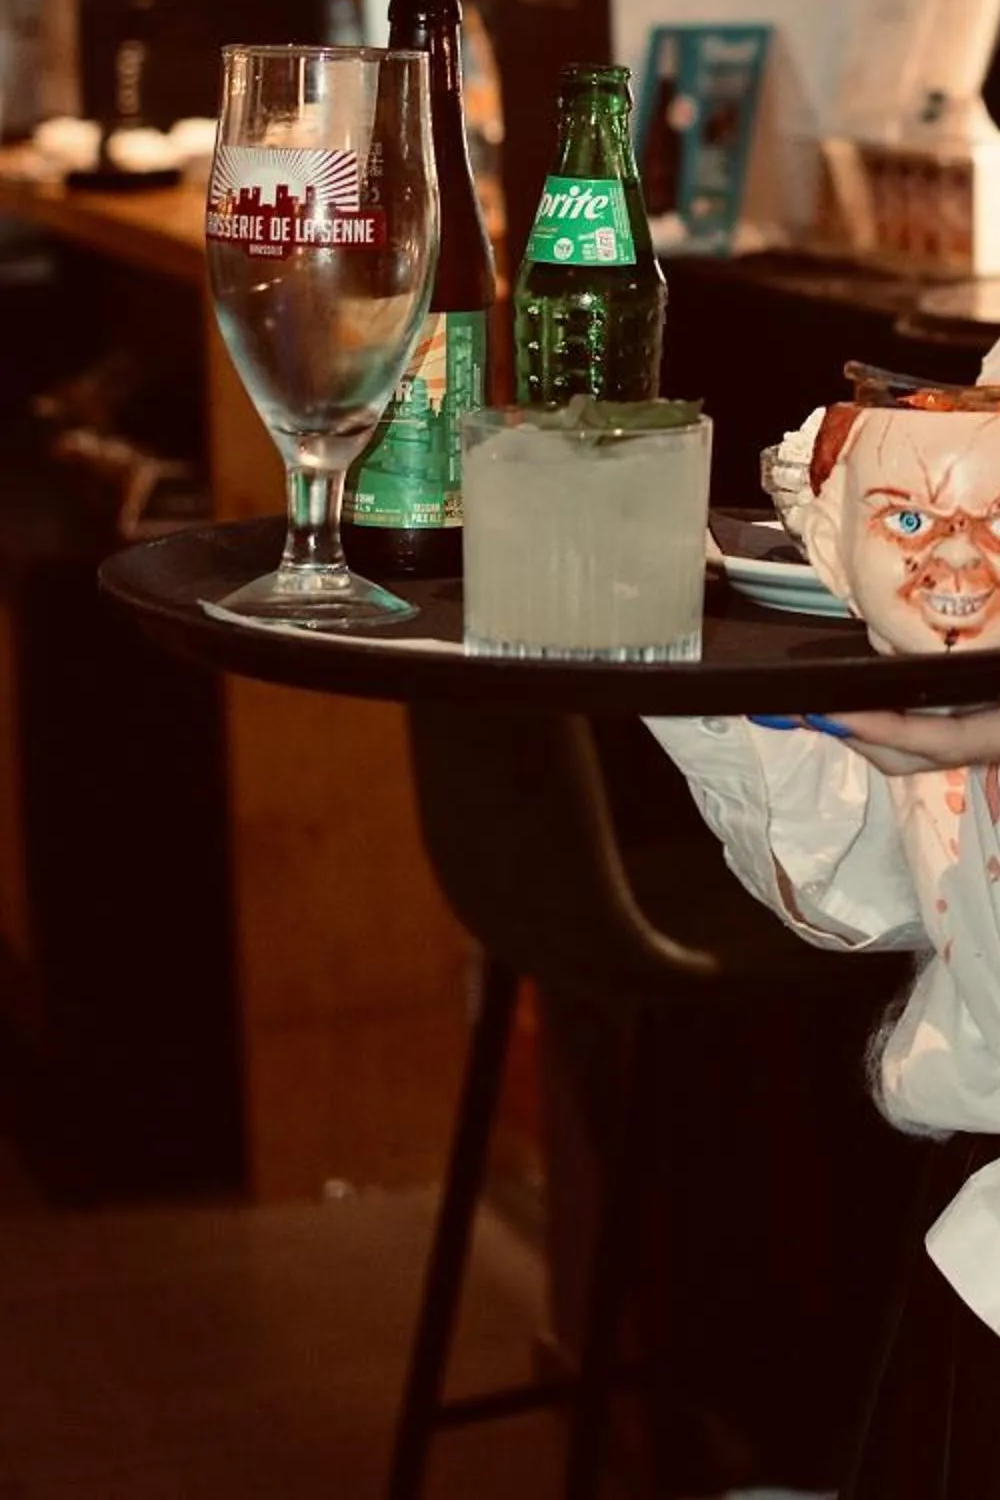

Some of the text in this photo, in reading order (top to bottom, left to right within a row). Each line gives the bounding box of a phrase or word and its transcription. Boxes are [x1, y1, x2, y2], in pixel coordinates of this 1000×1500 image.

[535, 186, 609, 225] prite
[270, 216, 291, 242] DE
[295, 217, 316, 243] LA
[320, 217, 375, 244] SENNE
